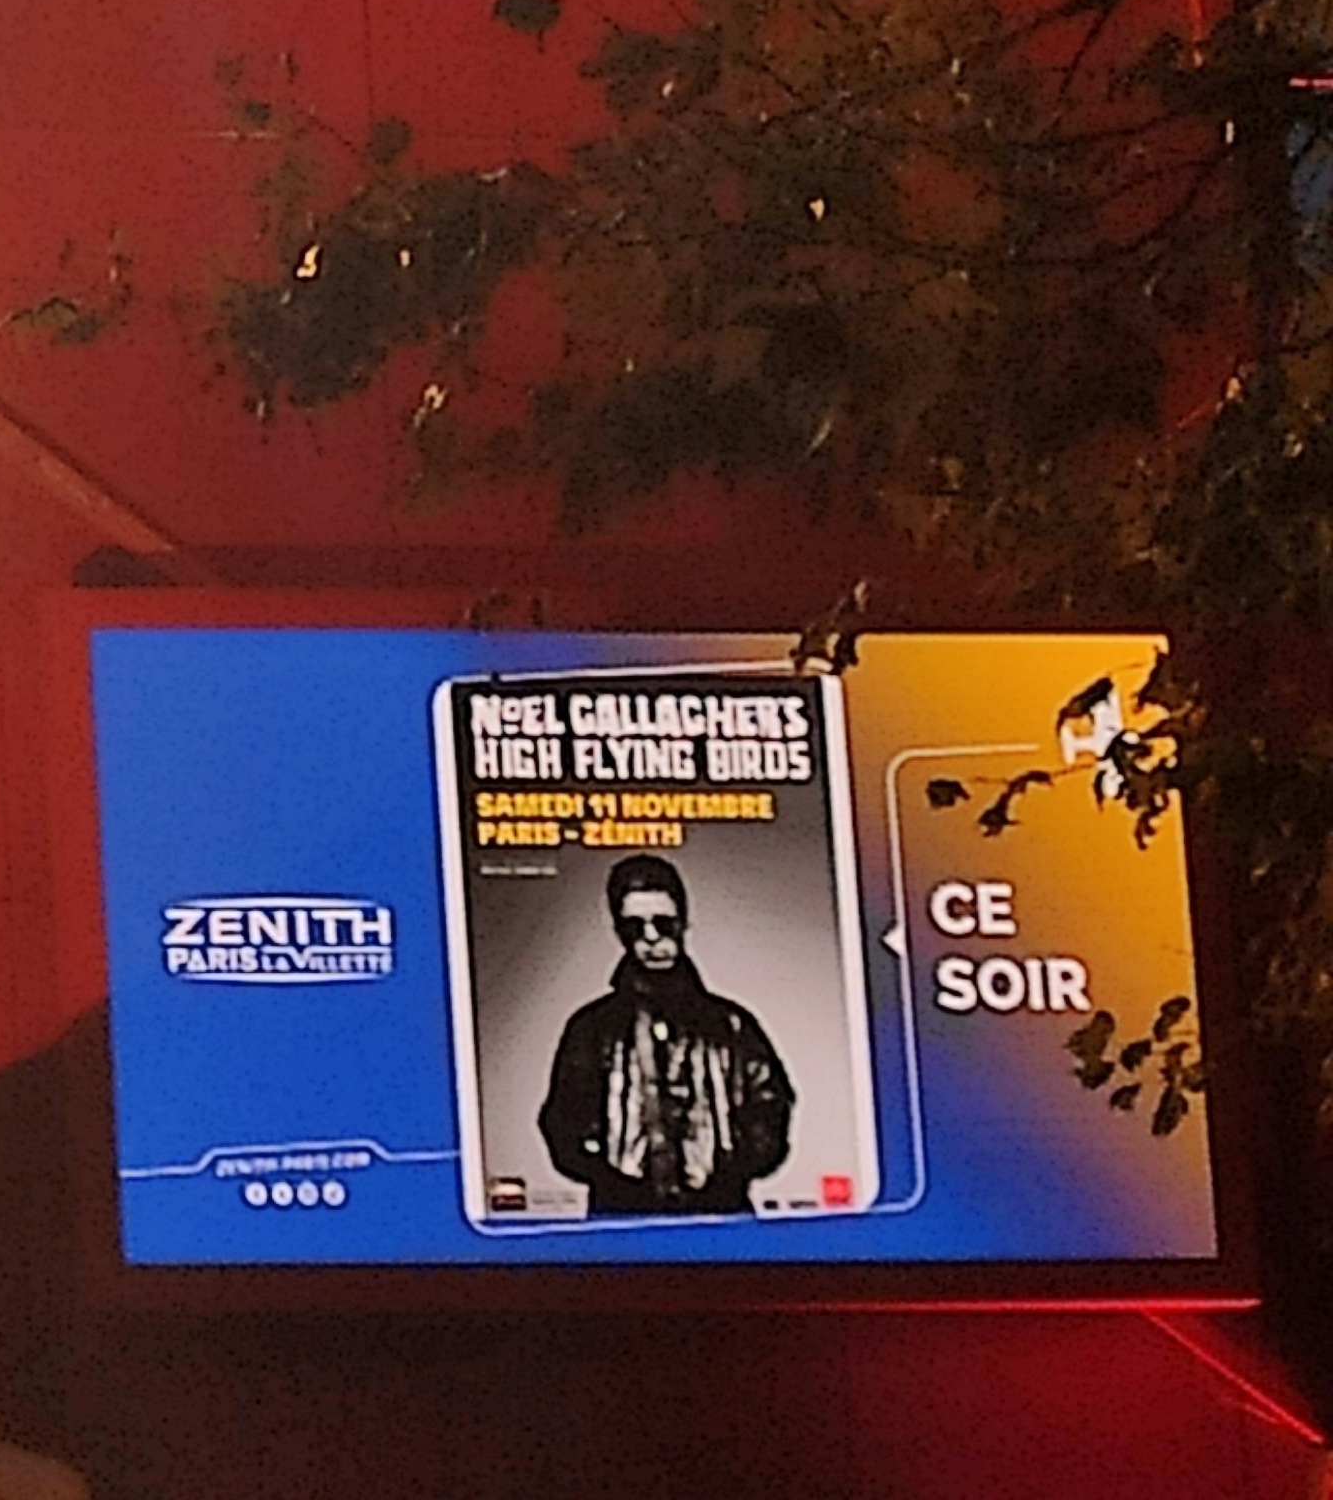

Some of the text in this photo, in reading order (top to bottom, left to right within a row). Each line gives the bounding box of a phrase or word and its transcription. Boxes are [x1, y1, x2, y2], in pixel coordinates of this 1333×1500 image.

[474, 737, 812, 781] HIGH FLYING BIRDS
[475, 792, 775, 820] SAMEDI 11 NOVEMBRE
[477, 821, 561, 846] PARIS
[162, 907, 392, 946] ZENITH
[930, 881, 1017, 936] CE
[166, 947, 259, 974] PARIS
[935, 956, 1092, 1012] SOIR
